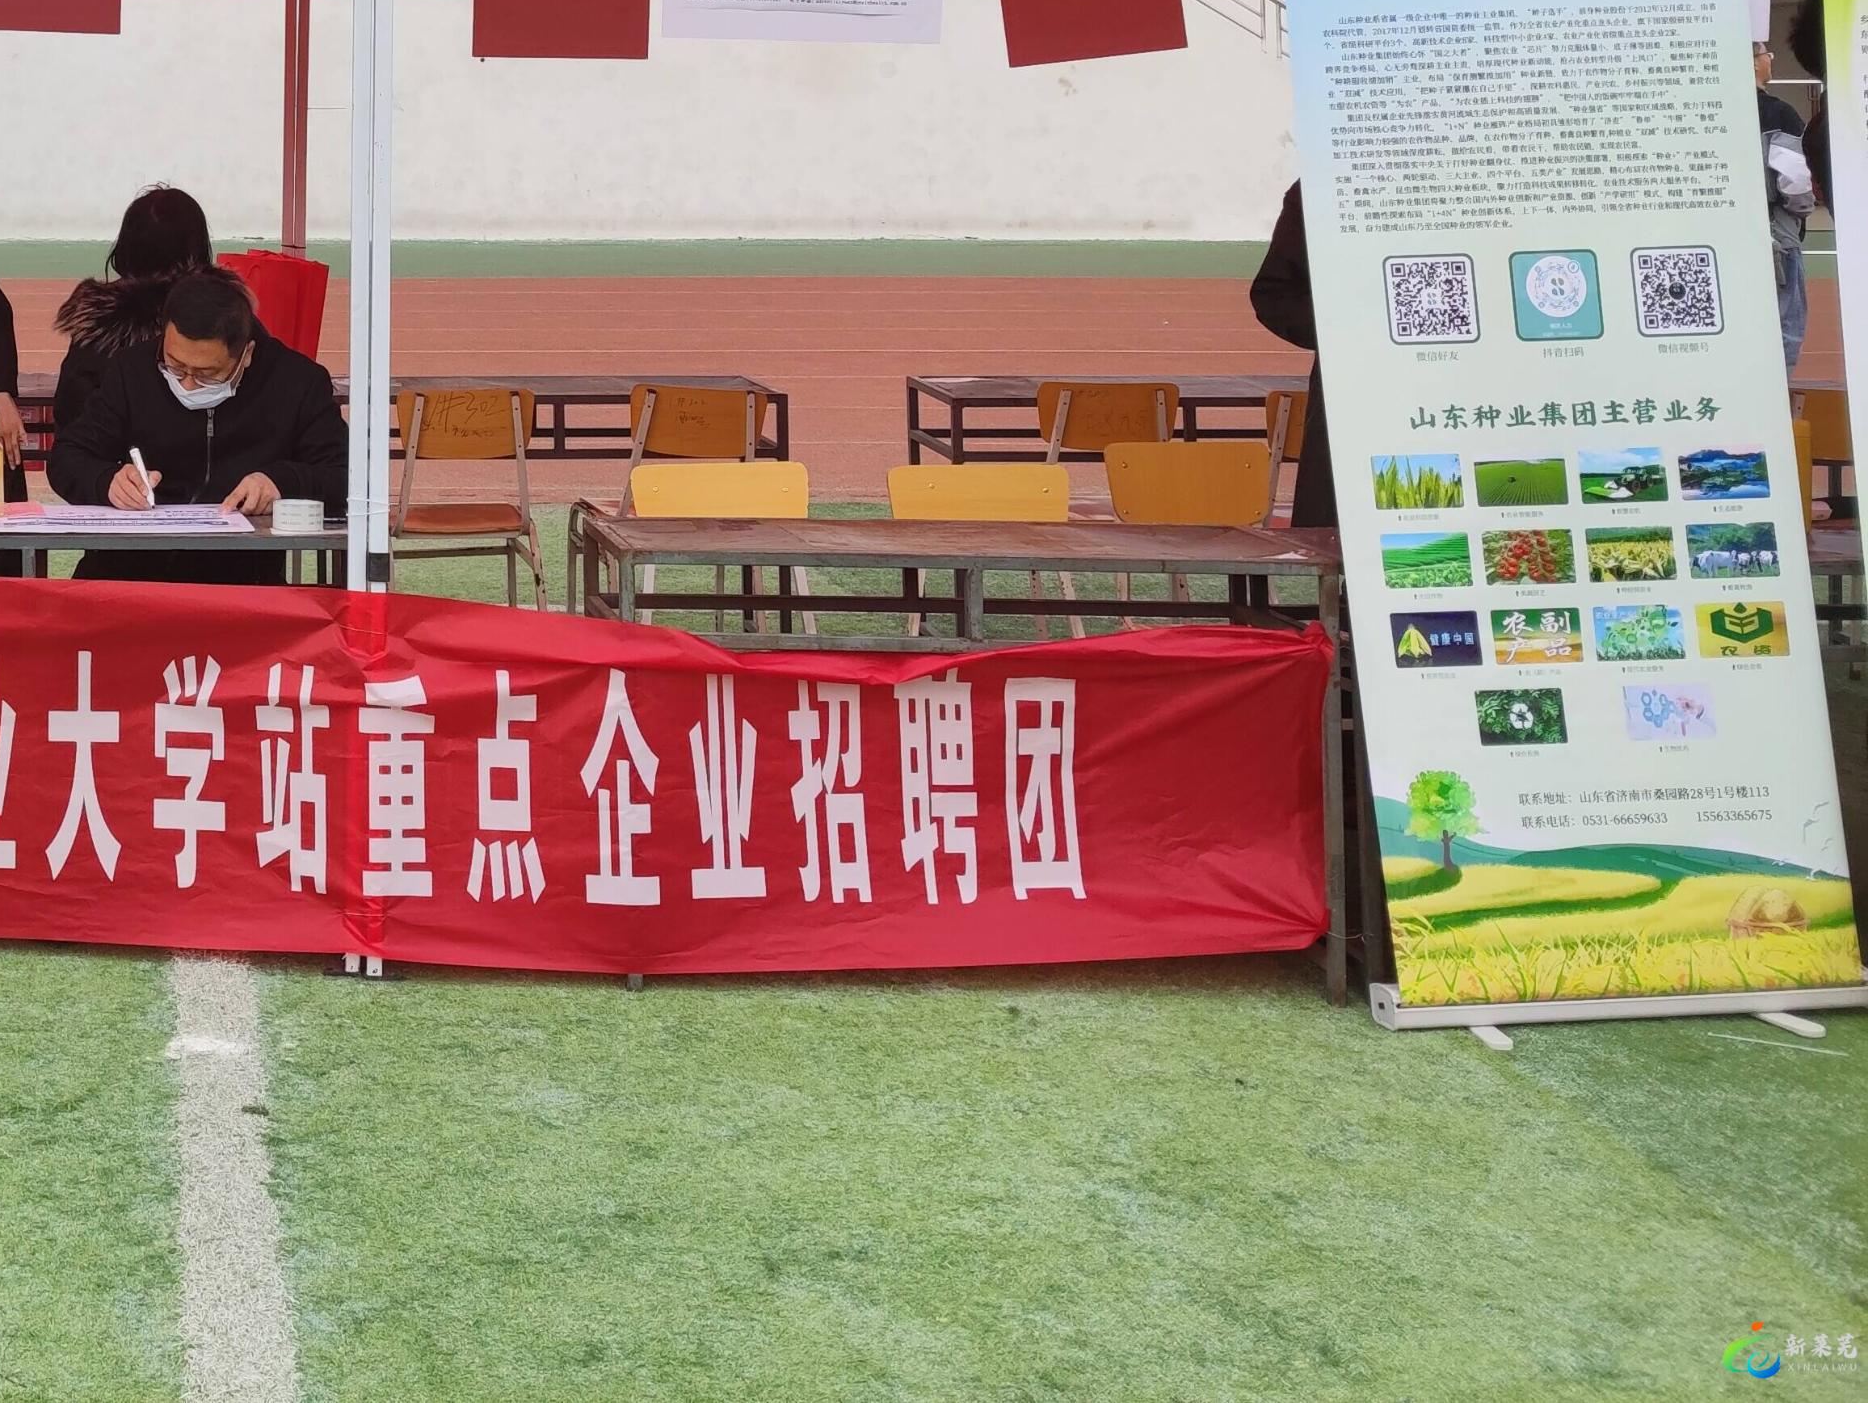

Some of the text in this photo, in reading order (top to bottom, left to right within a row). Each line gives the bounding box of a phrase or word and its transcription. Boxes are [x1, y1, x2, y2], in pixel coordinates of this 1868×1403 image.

[1543, 346, 1584, 359] 抖音扫码
[1658, 342, 1709, 354] 微信视频号
[1416, 350, 1460, 362] 微信好友
[1410, 397, 1723, 431] 山东种业集团主营业务
[1503, 611, 1571, 635] 农副
[1429, 632, 1475, 647] 健康中国
[1505, 638, 1573, 663] 产品
[1697, 809, 1773, 823] 15563365675
